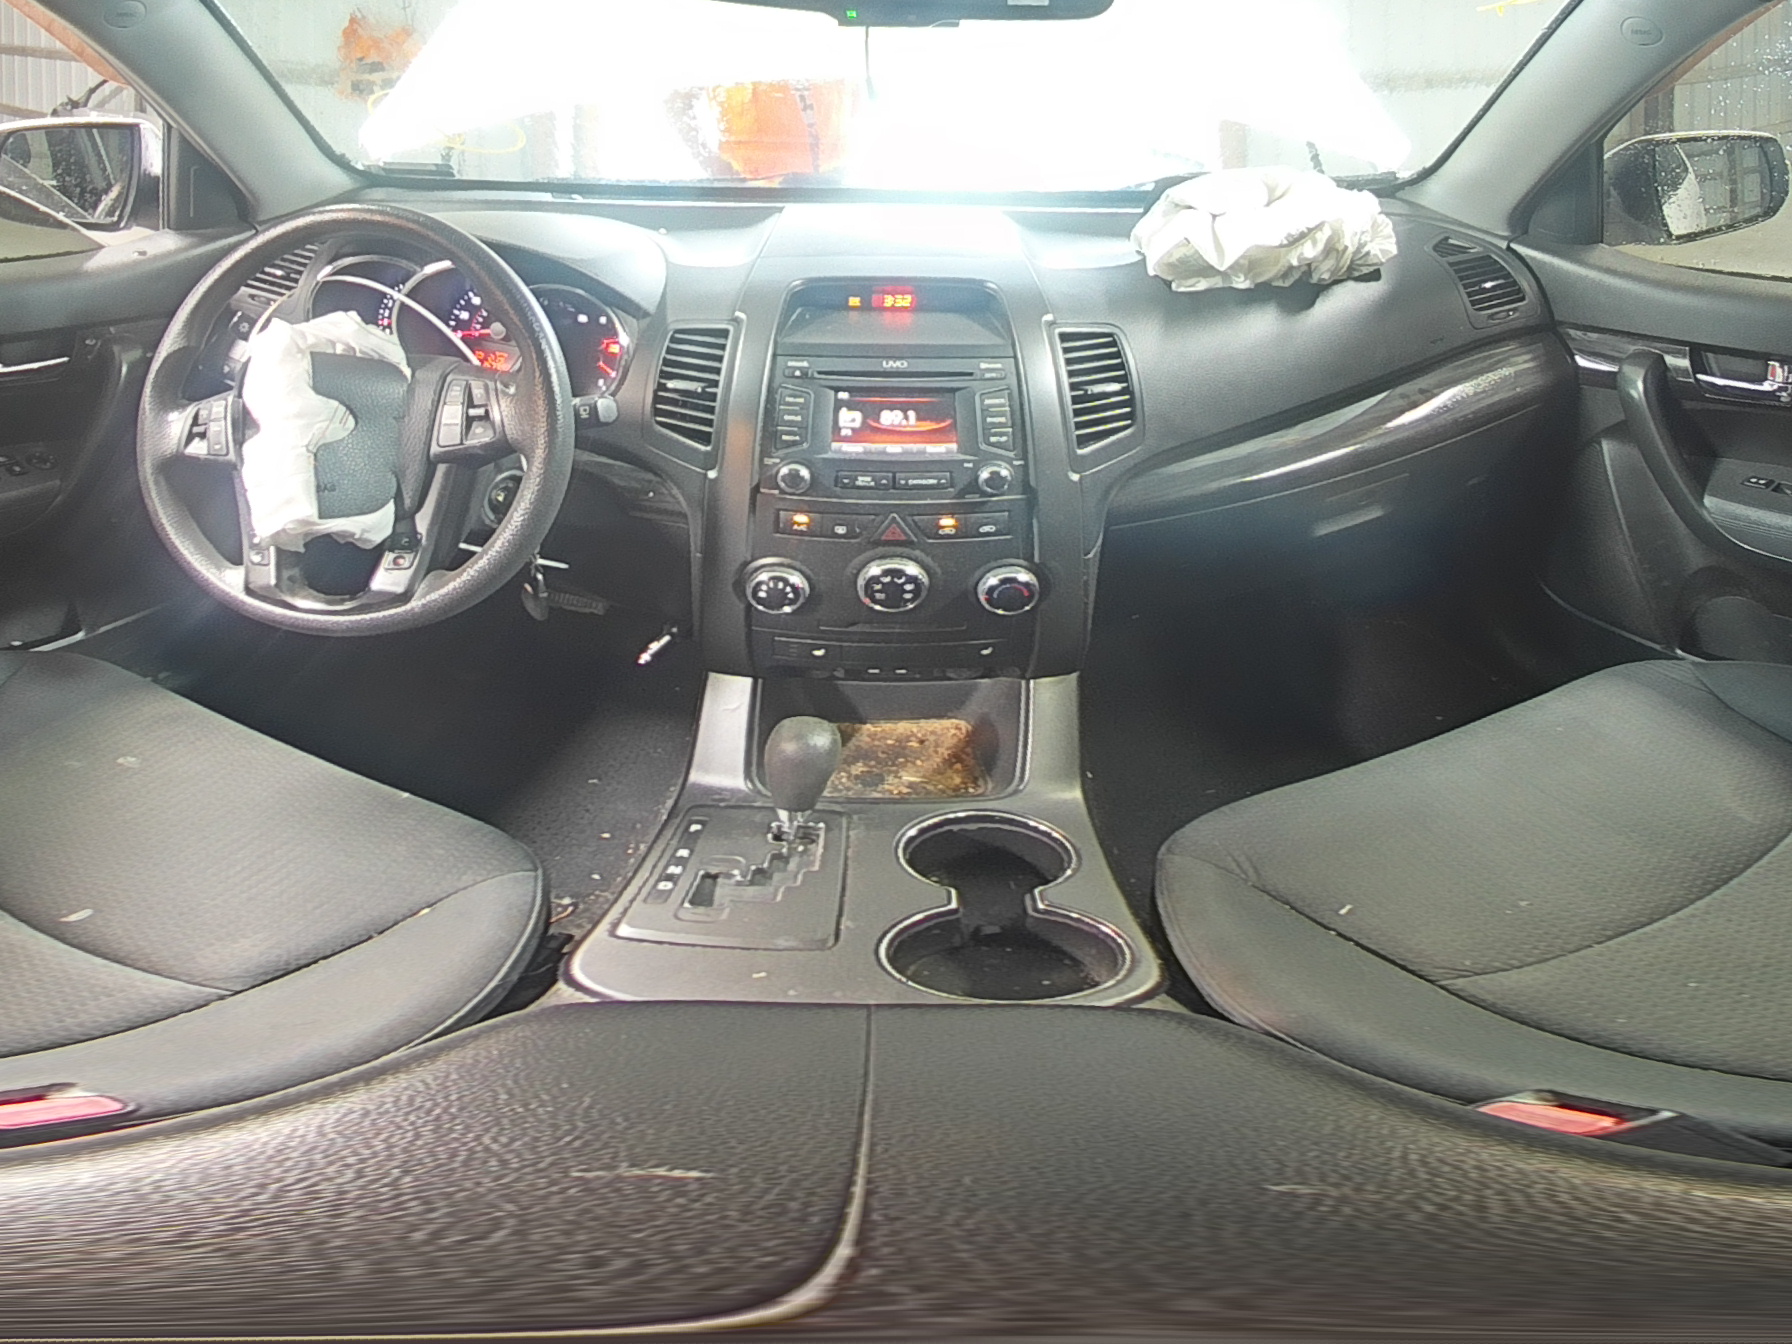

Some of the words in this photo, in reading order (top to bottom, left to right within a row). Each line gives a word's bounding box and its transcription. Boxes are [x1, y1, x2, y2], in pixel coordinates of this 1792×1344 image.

[883, 294, 912, 308] 3:32
[882, 359, 908, 369] UVO
[879, 409, 917, 426] 89.1
